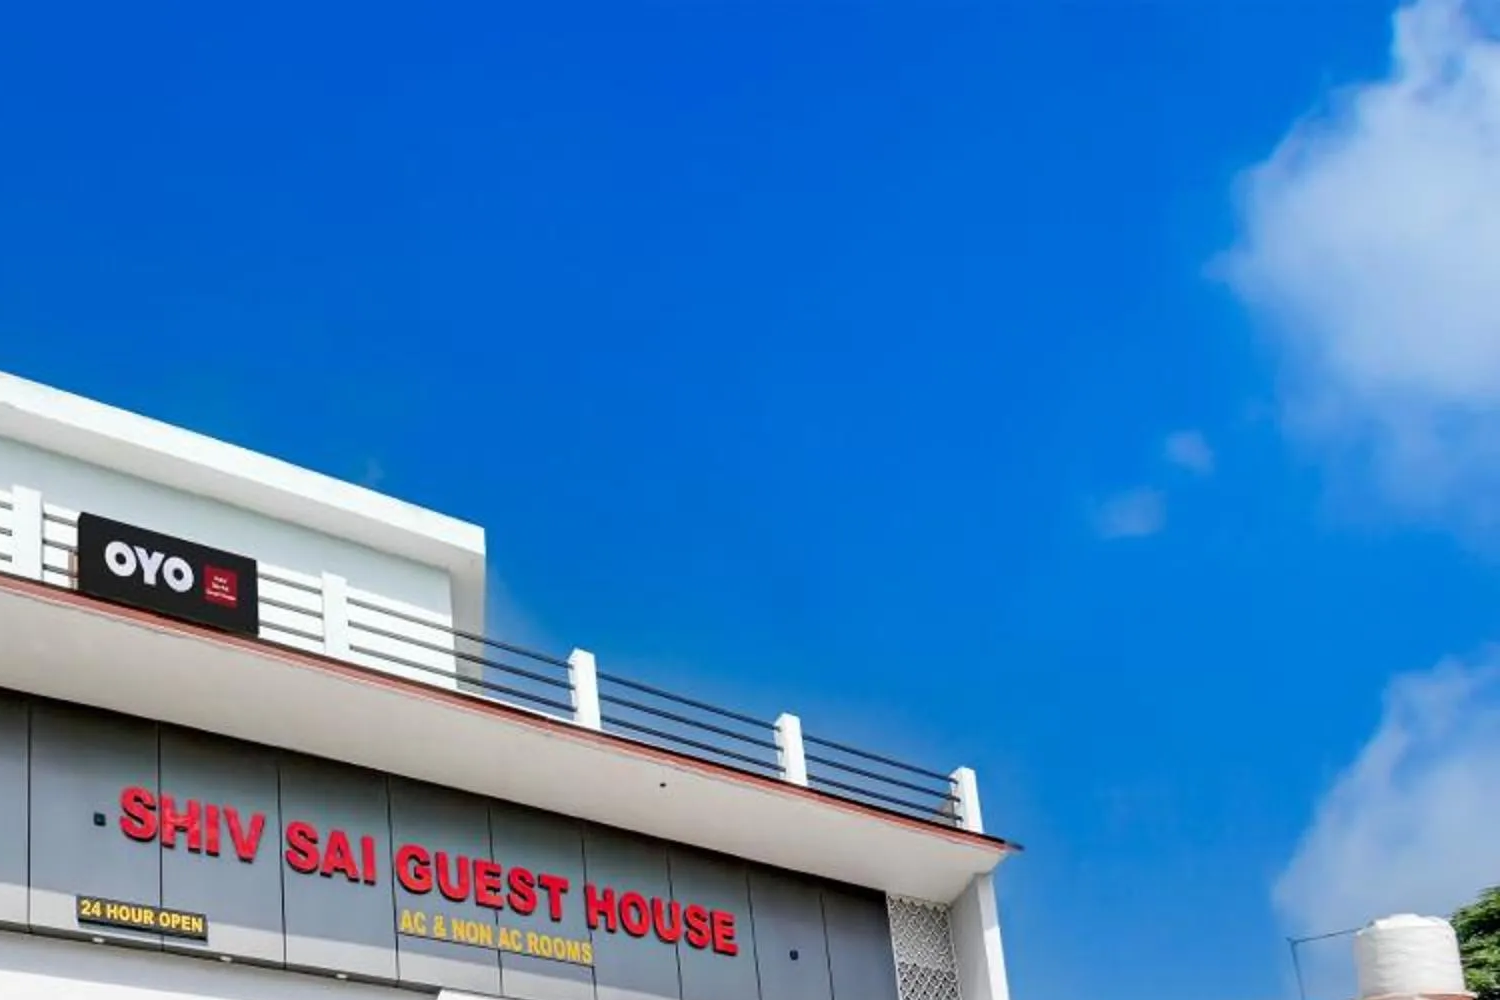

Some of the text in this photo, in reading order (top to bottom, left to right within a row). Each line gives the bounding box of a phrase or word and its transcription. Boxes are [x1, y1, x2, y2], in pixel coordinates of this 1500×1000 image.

[104, 540, 194, 593] OYO
[119, 786, 739, 956] SHIV SAI GUEST HOUSE
[81, 900, 203, 932] 24 HOUR OPEN
[400, 909, 593, 964] AC & NON AC ROOMS
